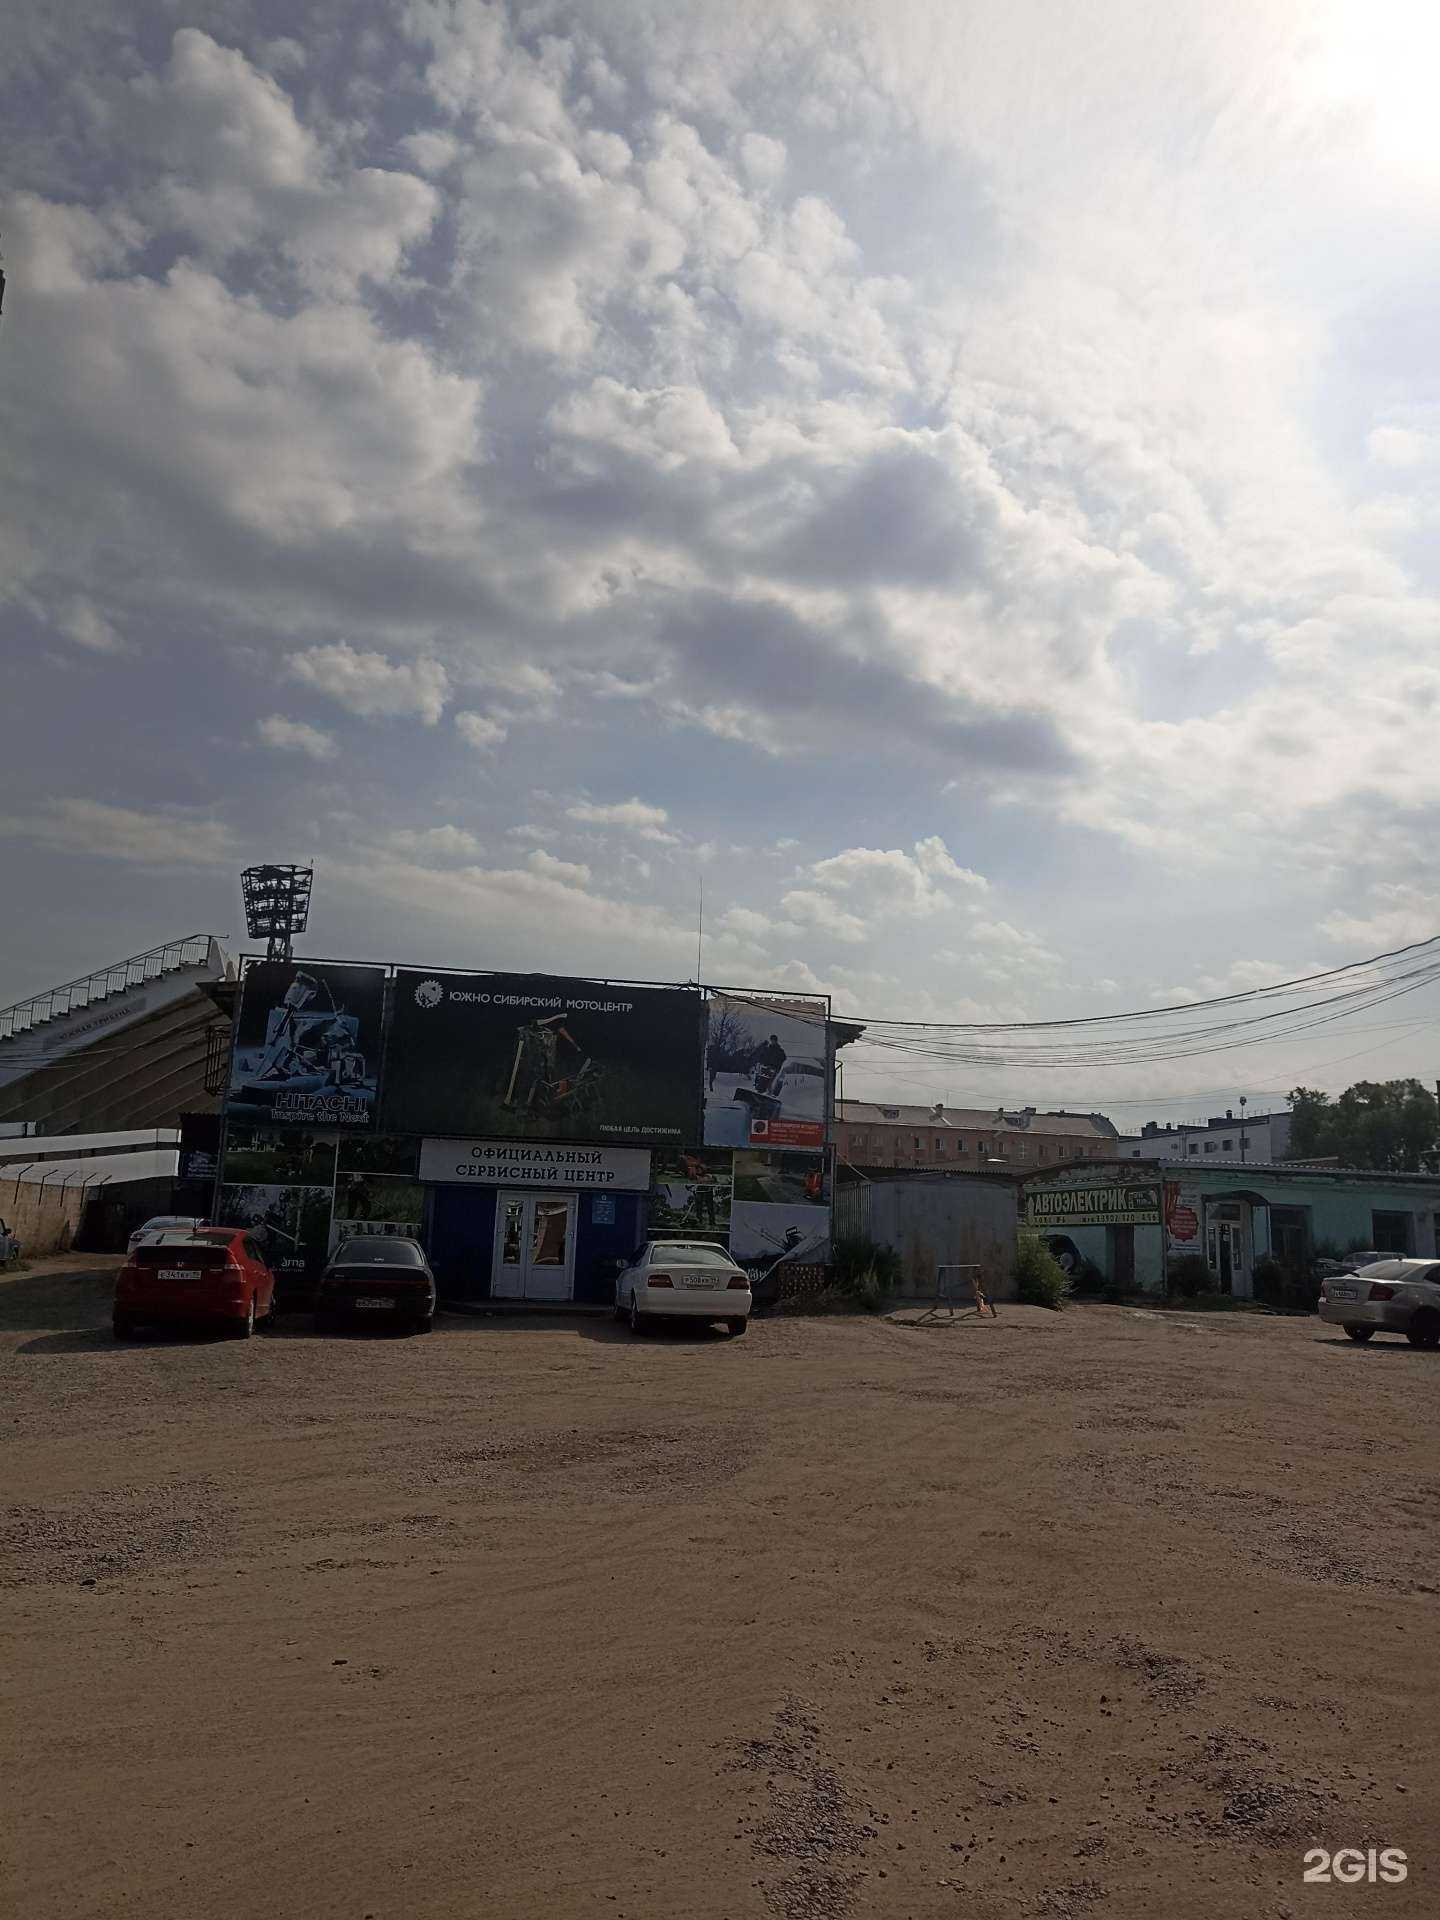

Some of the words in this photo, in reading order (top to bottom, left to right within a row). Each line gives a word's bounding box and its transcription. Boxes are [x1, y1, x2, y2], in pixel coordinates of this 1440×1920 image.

[449, 991, 491, 1005] ЮЖНО
[492, 994, 562, 1009] СИБИРСКИЙ
[566, 998, 633, 1014] МОТОЦЕНТР
[275, 1092, 368, 1112] HITACHI
[271, 1109, 314, 1122] Inspire
[316, 1111, 337, 1122] the
[641, 1126, 681, 1136] ДОСТИЖИМА
[471, 1146, 602, 1165] ОФИЦИАЛЬНЫЙ
[456, 1164, 558, 1181] СЕРВИСНЫЙ
[564, 1169, 615, 1184] ЦЕНТР
[1034, 1188, 1127, 1213] АВТОЭЛЕКТРИК
